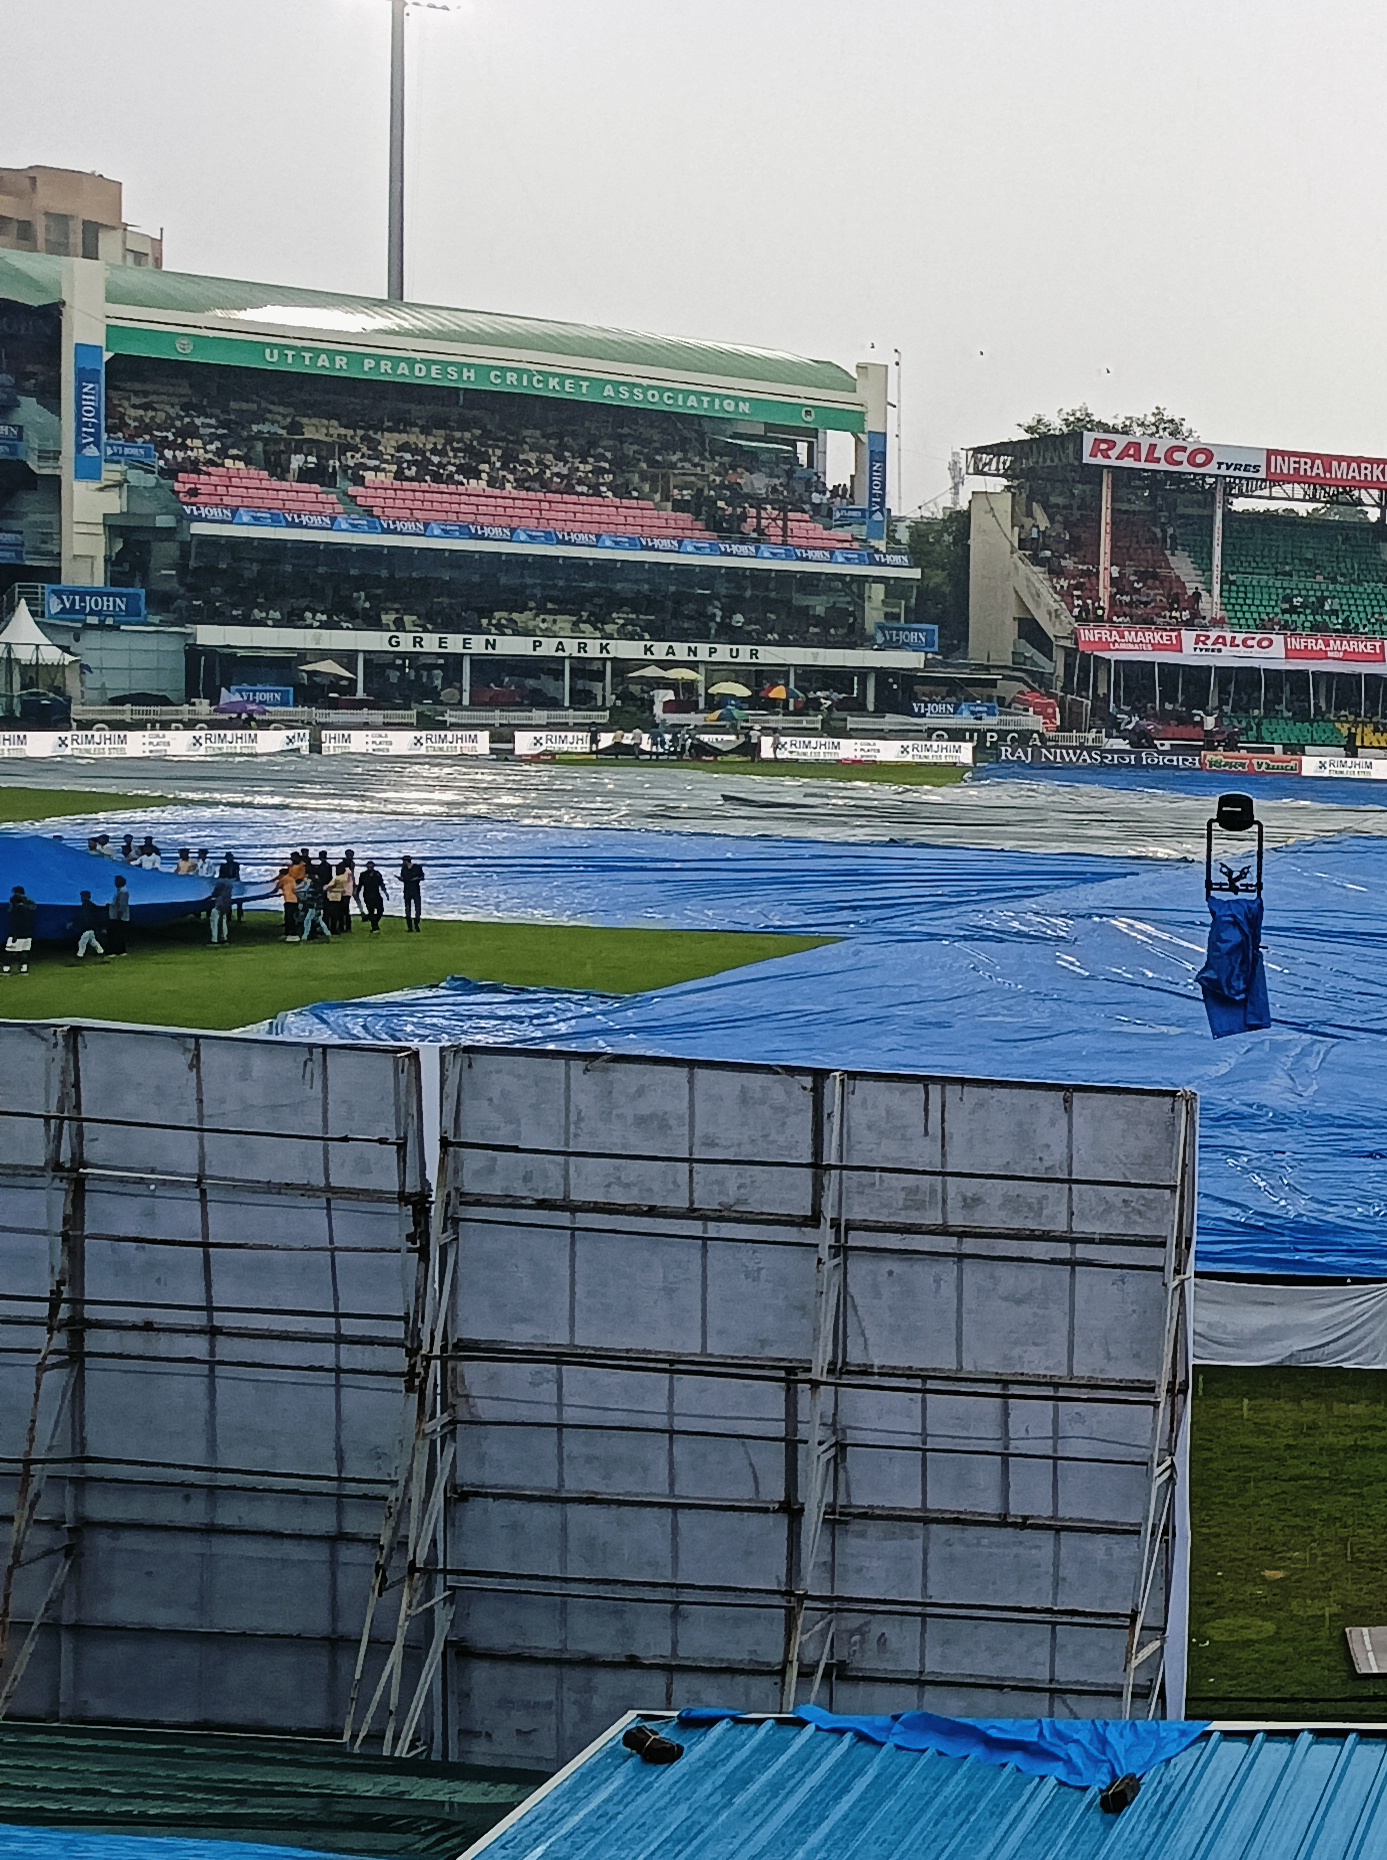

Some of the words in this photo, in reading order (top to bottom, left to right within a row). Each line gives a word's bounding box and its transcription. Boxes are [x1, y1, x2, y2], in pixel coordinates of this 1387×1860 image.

[264, 348, 348, 370] UTTAR
[363, 358, 476, 382] PRADESH
[489, 370, 590, 395] CRICKET
[603, 384, 750, 414] ASSOCIATION
[81, 382, 99, 445] VI-JOHN
[1089, 437, 1214, 468] RALCO
[1216, 462, 1261, 474] TYRES
[871, 462, 883, 512] VI-JOHN
[183, 505, 232, 519] VI-JOHN
[284, 513, 331, 526] VI-JOHN
[469, 525, 511, 537] VI-JOHN
[556, 531, 596, 544] VI-JOHN
[718, 543, 756, 555] VI-JOHN
[874, 554, 909, 565] VI-JOHN
[61, 594, 127, 613] VI-JOHN
[884, 631, 927, 645] VI-JOHN
[1080, 629, 1178, 646] INFRA.MARKET
[1194, 633, 1274, 649] RALCO
[388, 634, 497, 651] GREEN
[532, 639, 612, 655] PARK
[643, 643, 760, 660] KANPUR
[1287, 637, 1382, 654] INFRA.MARKET
[912, 702, 955, 714] VI-JOHN
[71, 734, 128, 746] RIMJHIM
[205, 733, 258, 744] RIMJHIM
[425, 733, 478, 745] RIMJHIM
[545, 734, 589, 745] RIMJHI
[790, 739, 841, 751] RIMJHIM
[912, 743, 962, 755] RIMJHIM
[1000, 746, 1032, 763] RAJ
[1041, 748, 1101, 764] NIWAS
[1102, 753, 1136, 766] राज
[1141, 752, 1200, 768] निवास
[1328, 759, 1373, 770] RIMJHIM
